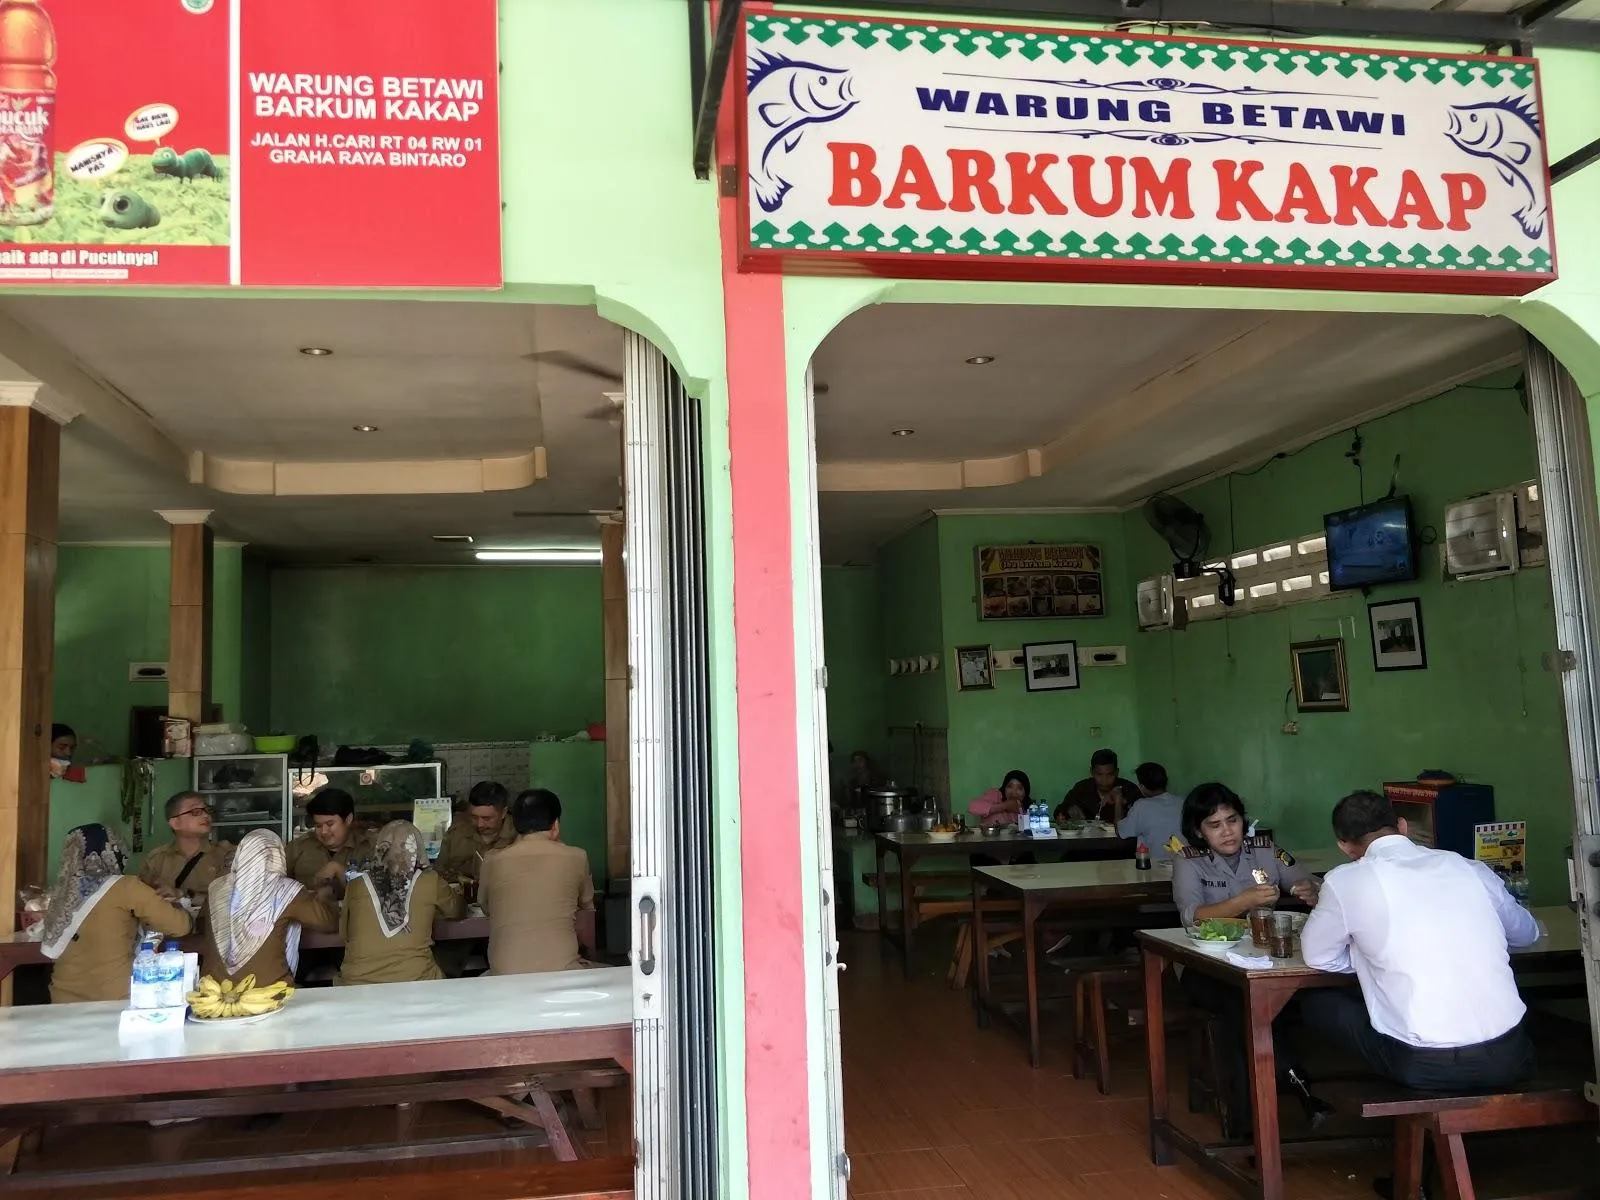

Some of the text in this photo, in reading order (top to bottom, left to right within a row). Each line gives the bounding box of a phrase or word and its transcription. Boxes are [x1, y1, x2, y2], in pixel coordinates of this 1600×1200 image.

[248, 72, 484, 100] WARUNG BETAWI
[255, 96, 480, 121] BARKUM KAKAP
[915, 87, 1407, 136] WARUNG BETAWI
[251, 132, 482, 152] JALAN H.CARI RT 04 RW 01
[70, 147, 113, 172] MANISNYA
[269, 150, 467, 167] GRAHA RAYA BINTARO
[827, 142, 1487, 231] BARKUM KAKAP
[29, 250, 59, 265] ada
[60, 249, 77, 265] di
[79, 249, 159, 267] Pucuknya!
